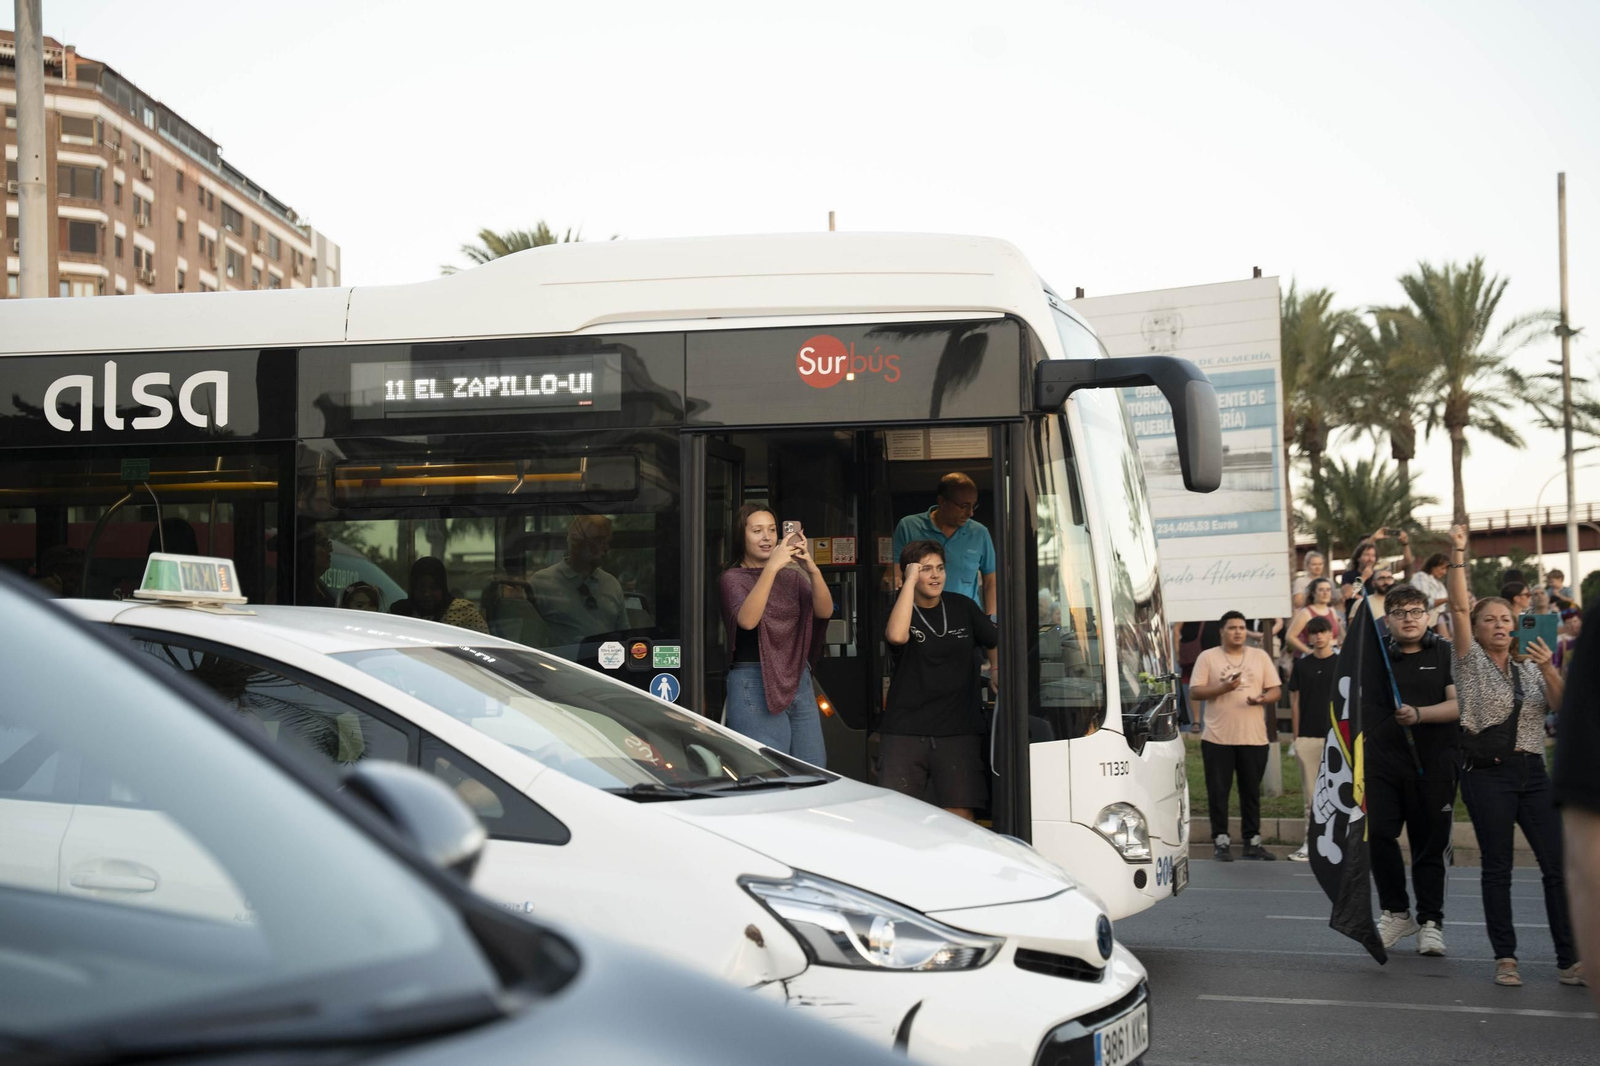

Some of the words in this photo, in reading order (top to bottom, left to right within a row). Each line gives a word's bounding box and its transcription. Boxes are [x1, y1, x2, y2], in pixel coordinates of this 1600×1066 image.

[1199, 357, 1214, 366] DE
[1217, 351, 1271, 363] ALMERÍA
[44, 360, 228, 432] alsa
[385, 380, 406, 400] 11
[414, 378, 444, 399] EL
[1128, 400, 1166, 416] TORNO
[1216, 391, 1247, 408] ENTE
[1249, 389, 1266, 405] DE
[1211, 519, 1239, 531] Euros
[181, 562, 217, 591] TAXI
[1099, 760, 1129, 777] 11330
[1103, 1022, 1130, 1066] 9861
